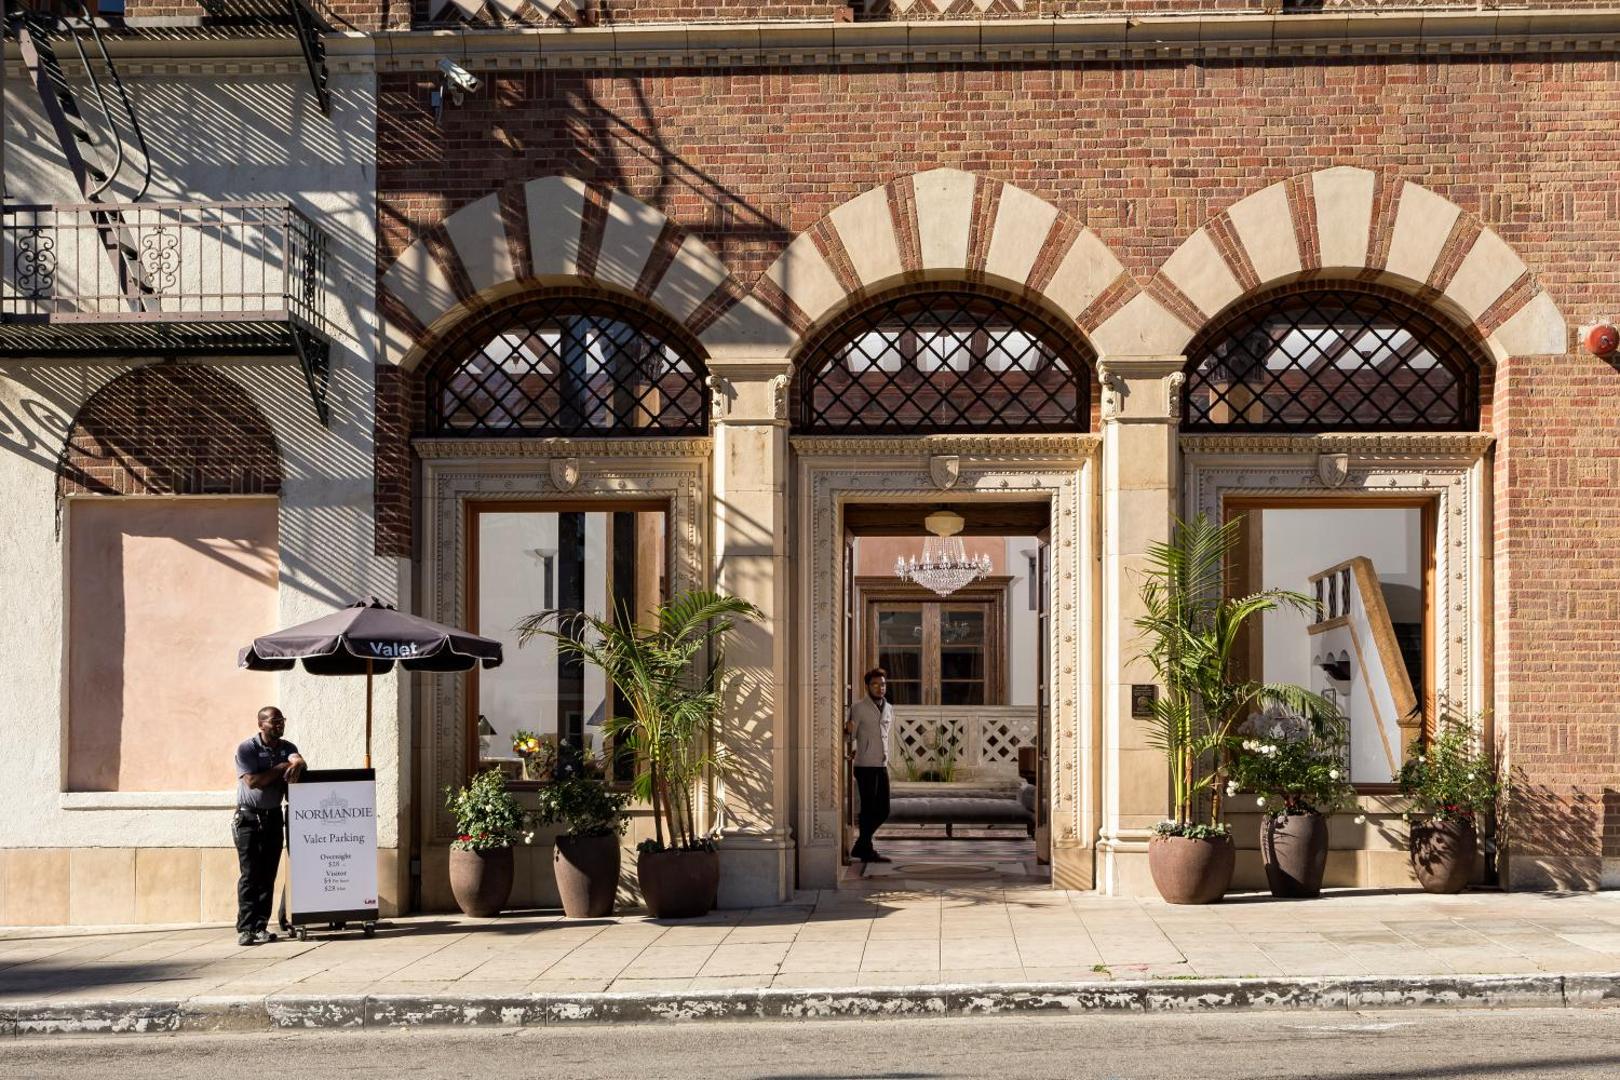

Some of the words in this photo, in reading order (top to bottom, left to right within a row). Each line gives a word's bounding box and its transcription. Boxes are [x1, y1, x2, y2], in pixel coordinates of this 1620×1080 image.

[369, 642, 418, 656] Valet
[295, 807, 373, 820] NORMANDIE
[303, 834, 326, 844] Valet
[329, 832, 365, 845] Parking
[320, 853, 351, 861] Overnight
